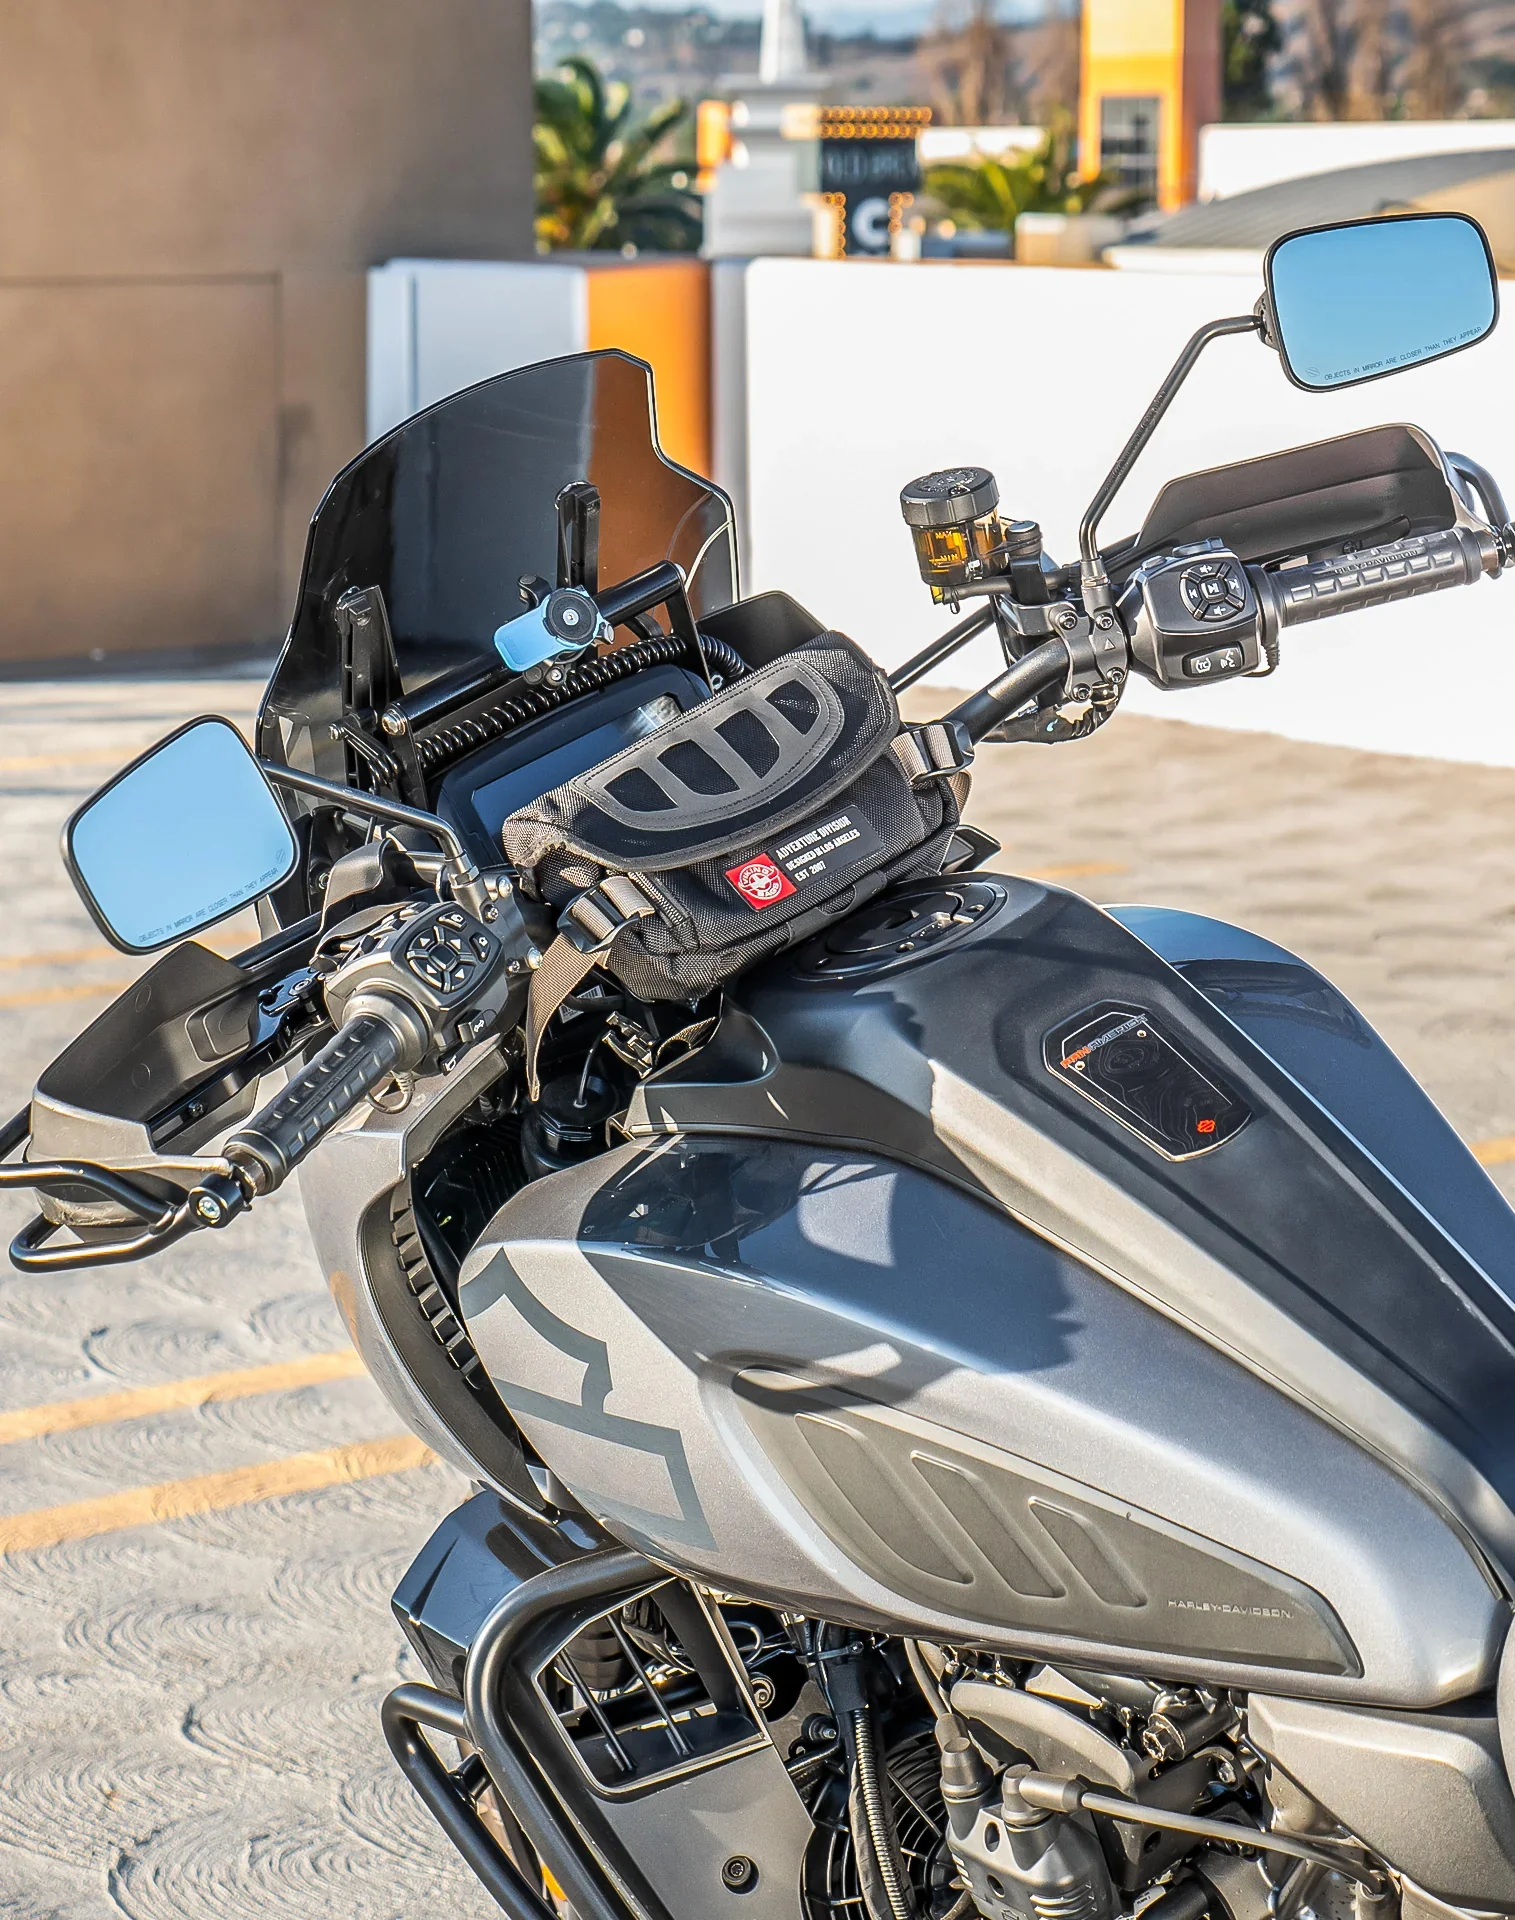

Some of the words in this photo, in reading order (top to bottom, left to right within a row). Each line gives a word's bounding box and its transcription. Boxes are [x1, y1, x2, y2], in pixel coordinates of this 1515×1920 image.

[1324, 370, 1351, 381] OBJECTS
[1353, 366, 1360, 374] IN
[1362, 360, 1384, 372] MIRROR
[1385, 356, 1397, 365] ARE
[1399, 349, 1422, 361] CLOSER
[1424, 342, 1441, 352] THAN
[1442, 336, 1457, 346] THEY
[1459, 326, 1482, 340] APPEAR
[775, 831, 822, 860] ADVENTURE
[817, 815, 852, 838] DIVISION
[785, 852, 818, 871] DESIGNED
[821, 841, 835, 854] LOS
[833, 828, 861, 848] ANGELES
[742, 866, 770, 885] VIKING
[757, 882, 779, 897] BAGS
[794, 868, 810, 882] EST
[810, 860, 827, 875] 2007
[138, 927, 165, 943] OBJECTS
[165, 923, 173, 931] IN
[173, 914, 193, 928] MIRROR
[195, 908, 206, 919] ARE
[207, 897, 229, 913] CLOSER
[229, 889, 244, 900] THAN
[244, 880, 258, 892] THEY
[259, 867, 279, 883] APPEAR
[1087, 1013, 1148, 1051] AMERICA
